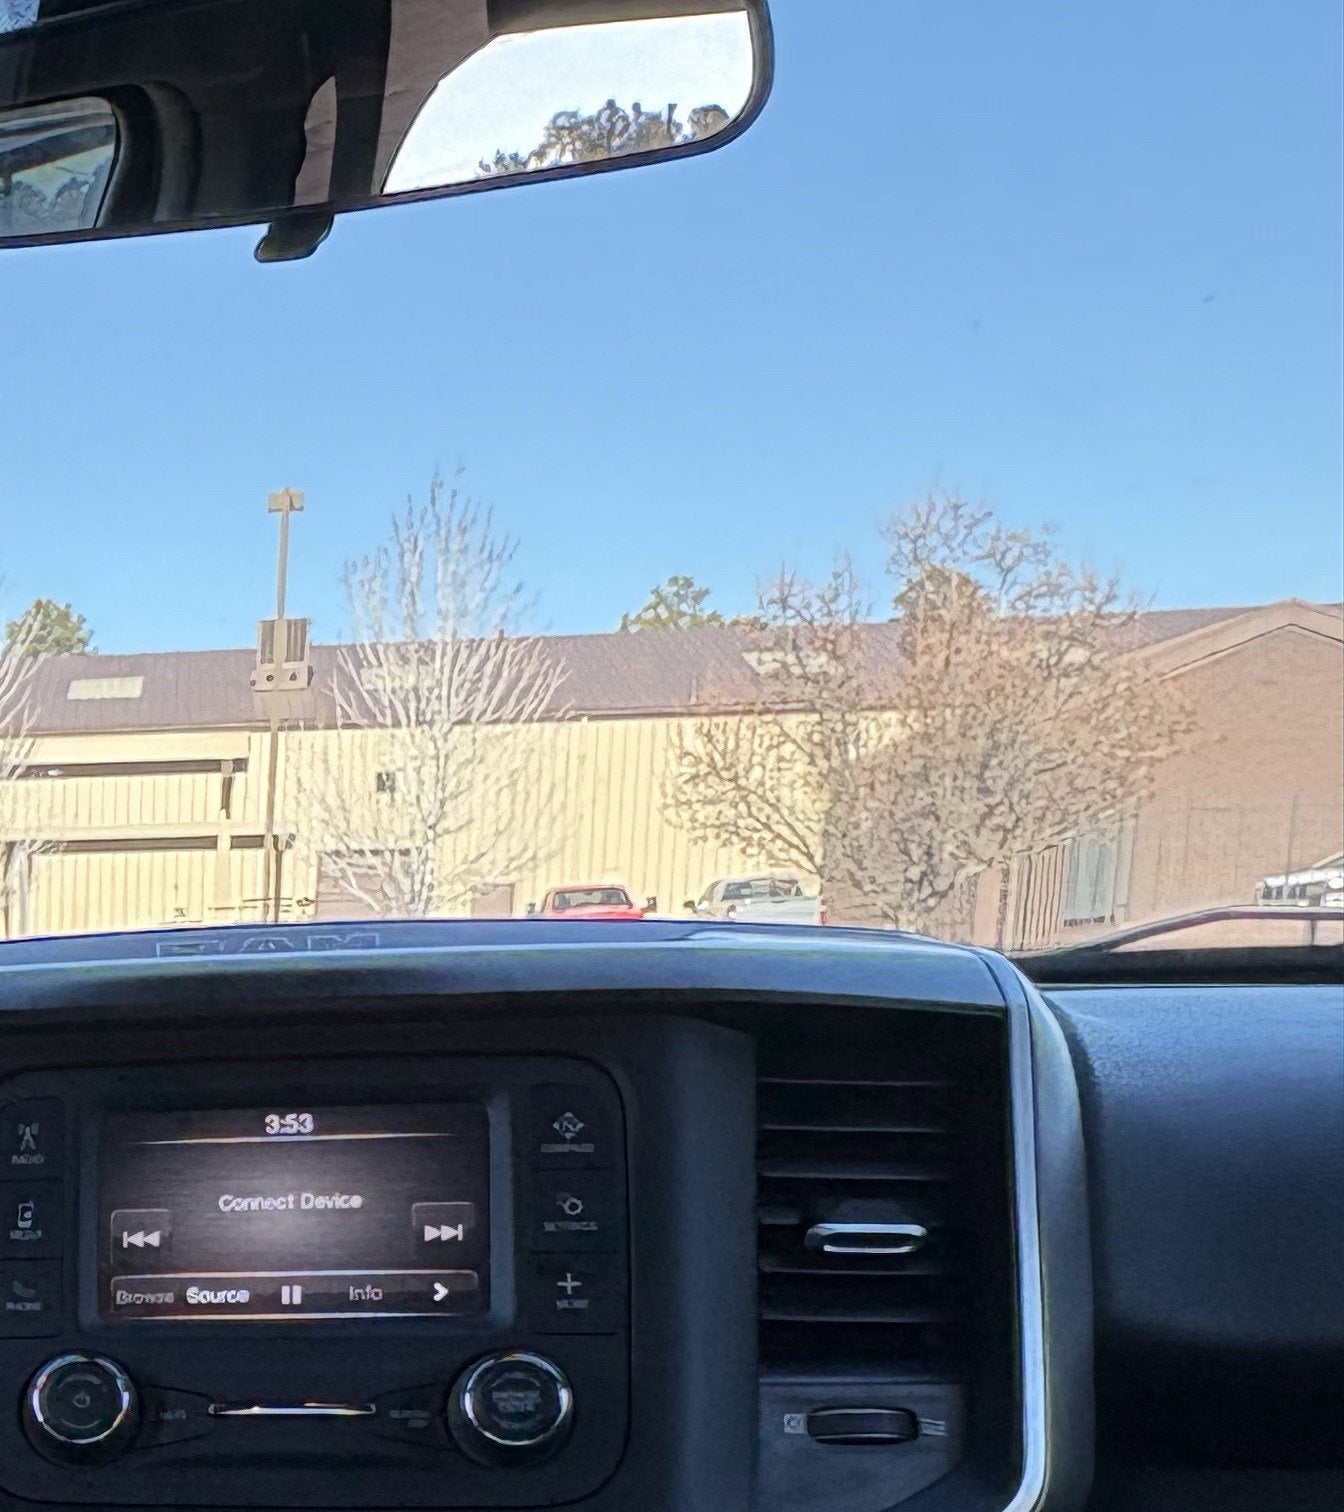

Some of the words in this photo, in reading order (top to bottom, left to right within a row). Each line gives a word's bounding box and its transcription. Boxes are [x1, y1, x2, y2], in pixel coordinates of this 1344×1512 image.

[264, 1113, 315, 1135] 3:53
[218, 1193, 295, 1213] Connect
[300, 1191, 364, 1210] Device
[185, 1286, 251, 1304] Source
[349, 1283, 384, 1301] Info
